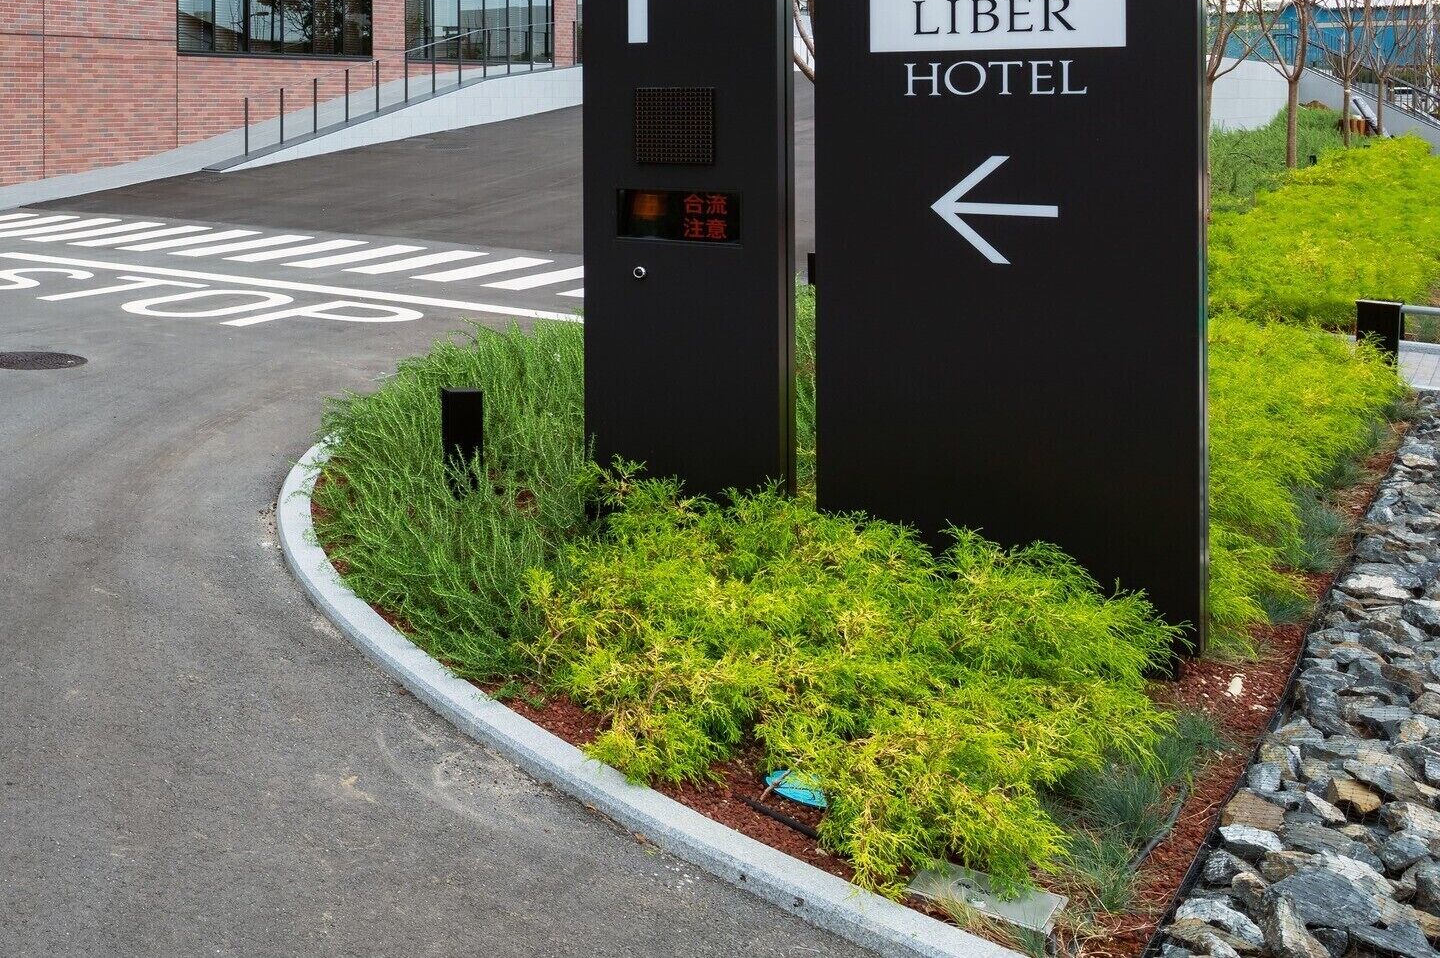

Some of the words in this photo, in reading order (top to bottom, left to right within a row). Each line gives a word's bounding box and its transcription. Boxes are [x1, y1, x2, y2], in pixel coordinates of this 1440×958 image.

[904, 59, 1088, 96] HOTEL
[683, 193, 728, 215] 合流
[683, 218, 728, 239] 注意
